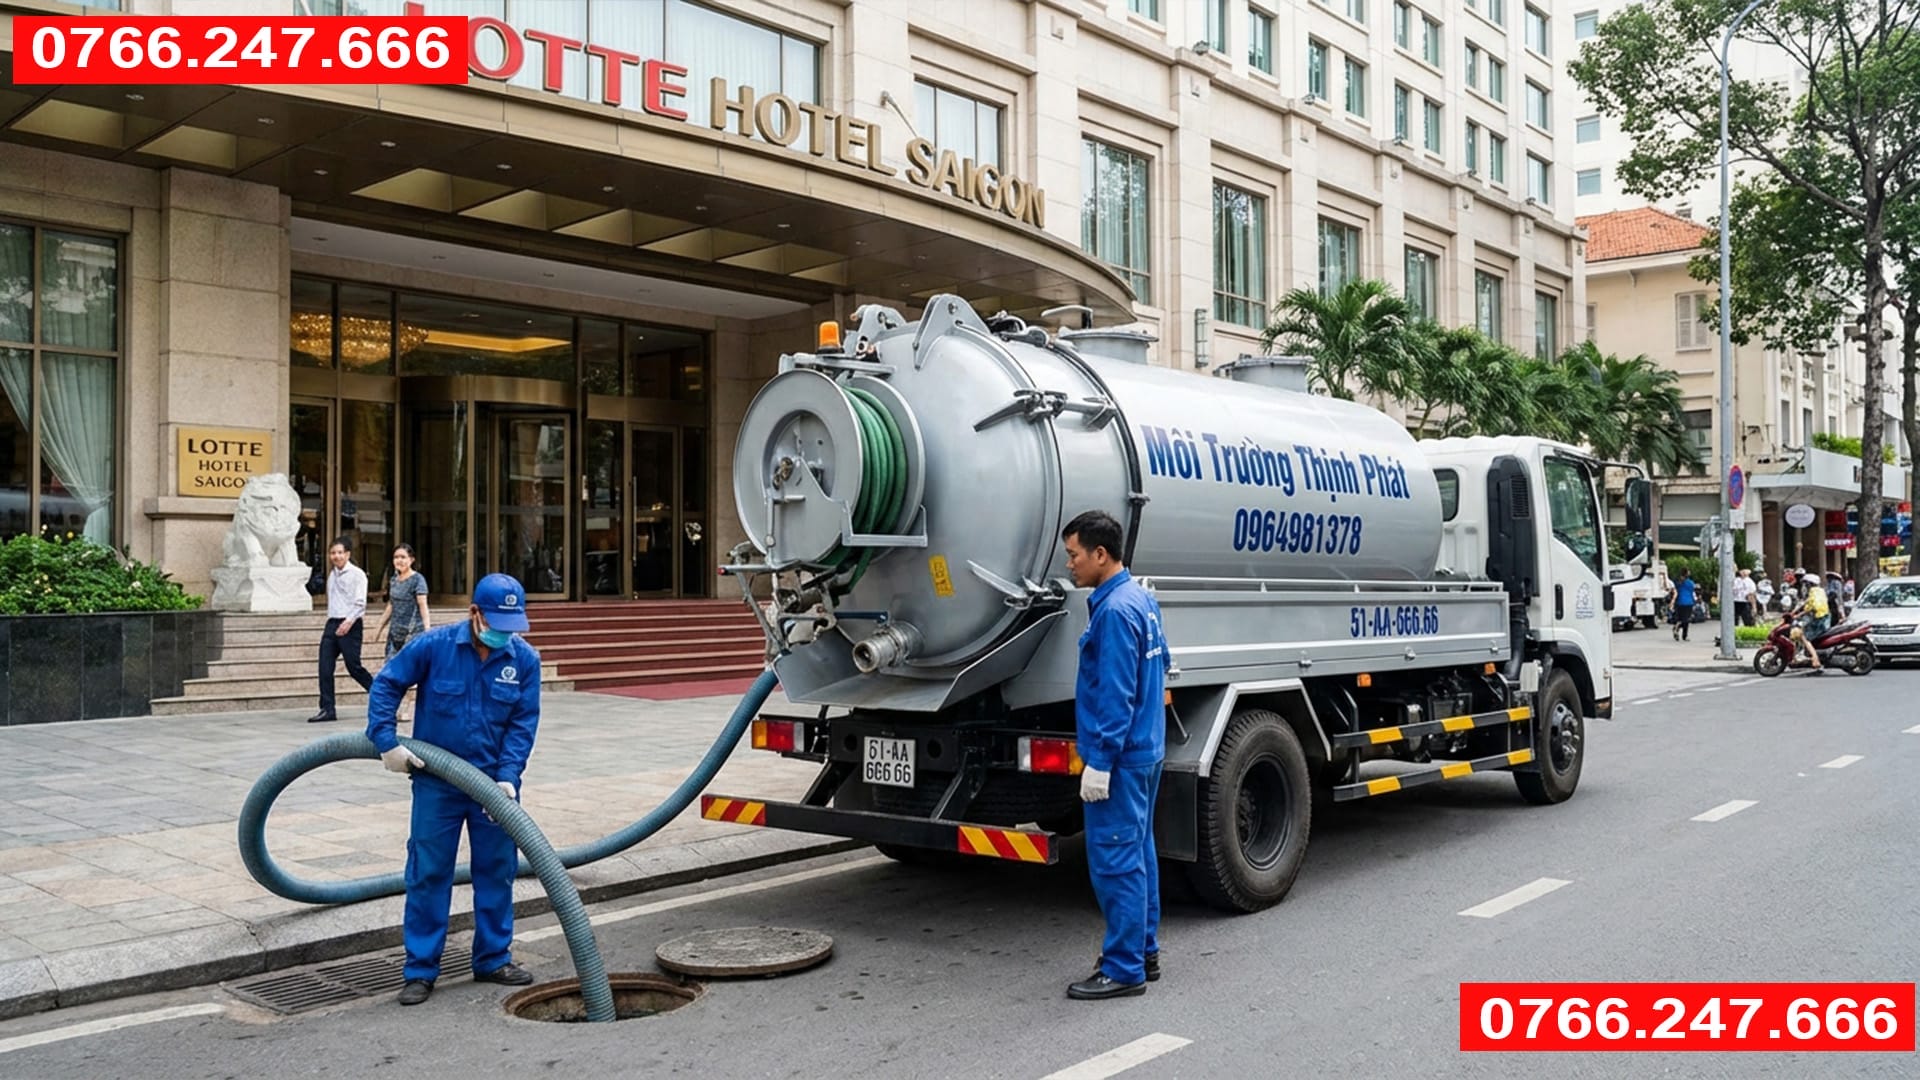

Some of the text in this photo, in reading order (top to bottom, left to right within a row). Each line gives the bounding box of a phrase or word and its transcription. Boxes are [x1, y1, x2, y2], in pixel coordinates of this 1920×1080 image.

[404, 2, 1045, 229] OTTE HOTEL SAIGON
[188, 438, 263, 457] LOTTE
[199, 459, 252, 473] HOTEL
[1140, 425, 1411, 503] Môi Trường Thịnh Phát
[1233, 508, 1363, 555] 0964981378
